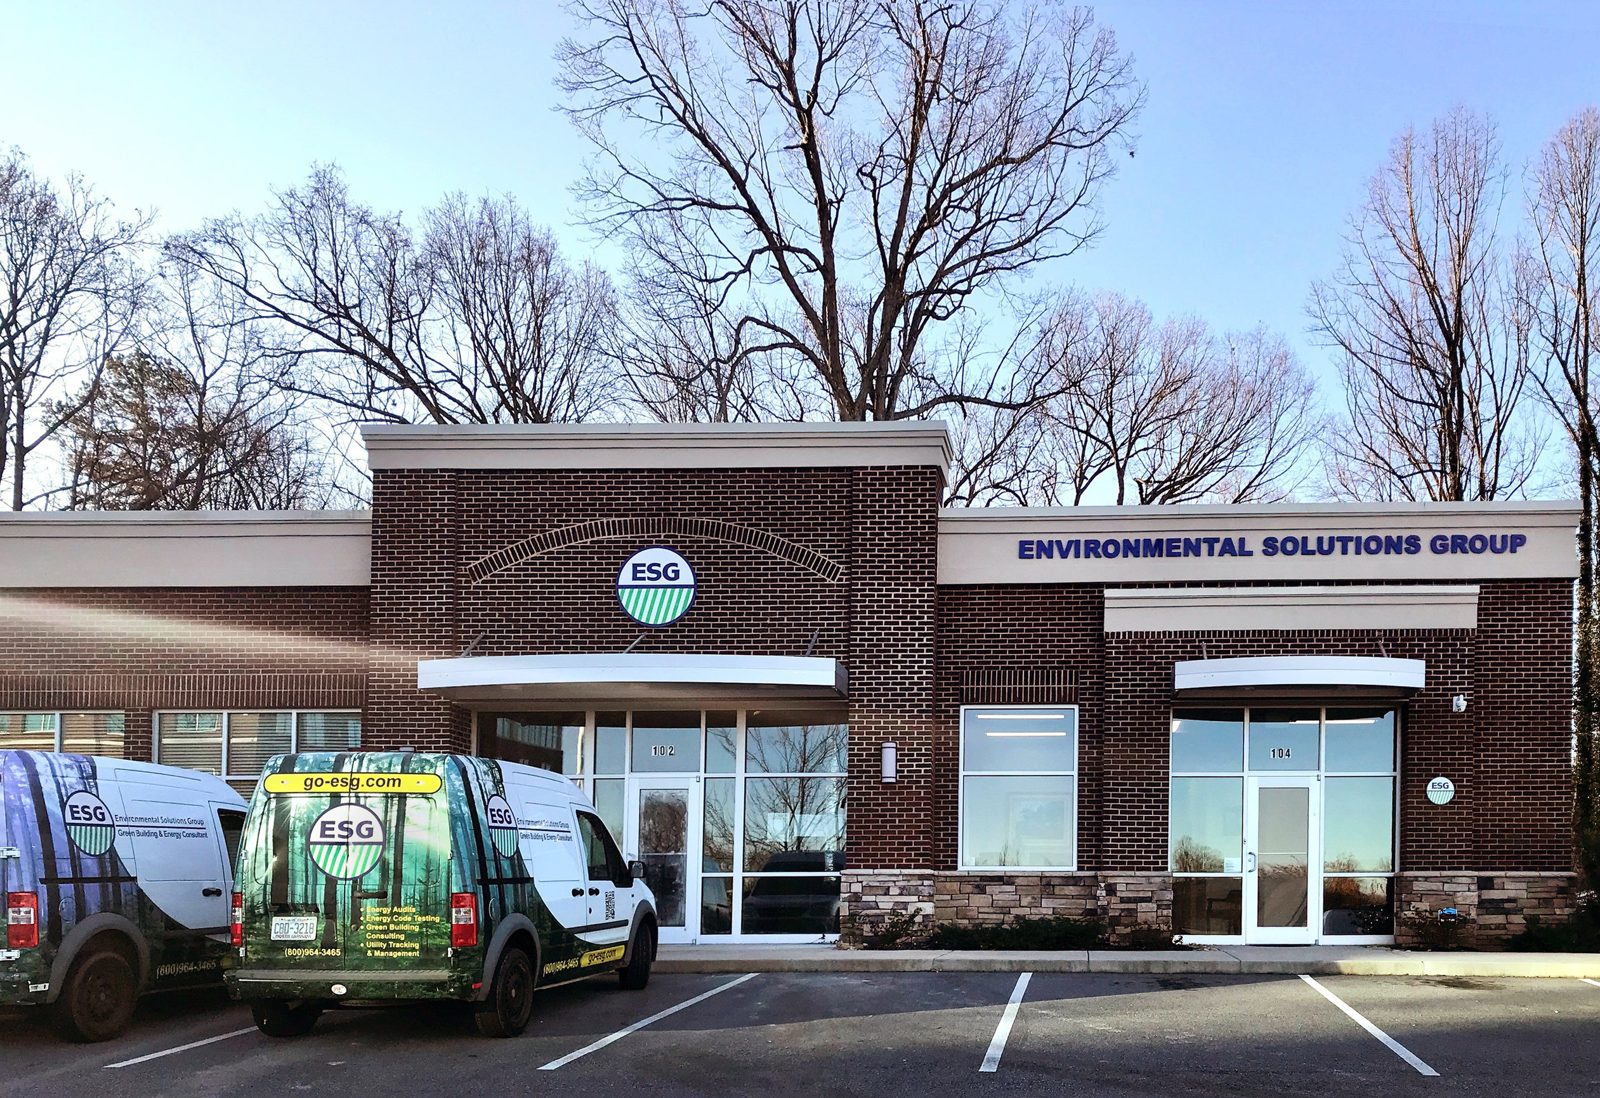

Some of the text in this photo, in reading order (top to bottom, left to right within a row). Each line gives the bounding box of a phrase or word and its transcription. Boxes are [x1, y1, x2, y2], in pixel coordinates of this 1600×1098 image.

[1018, 533, 1526, 559] ENVIRONMENTAL SOLUTIONS GROUP
[631, 562, 681, 582] ESG
[652, 745, 674, 756] 102
[1271, 748, 1291, 759] 104
[303, 775, 402, 791] go-esg.com
[1431, 781, 1450, 790] ESG
[69, 804, 106, 822] ESG
[489, 808, 512, 825] ESG
[118, 829, 135, 838] Green
[136, 830, 158, 839] Building
[164, 830, 181, 840] Energy
[319, 820, 375, 839] ESG
[366, 905, 416, 914] Energy Audits
[392, 914, 412, 922] Code
[413, 914, 440, 922] Testing
[389, 923, 420, 932] Building
[366, 932, 405, 940] Consulting
[366, 941, 420, 950] Utility Tracking
[284, 948, 341, 958] (800)964-3465
[373, 950, 420, 958] Management
